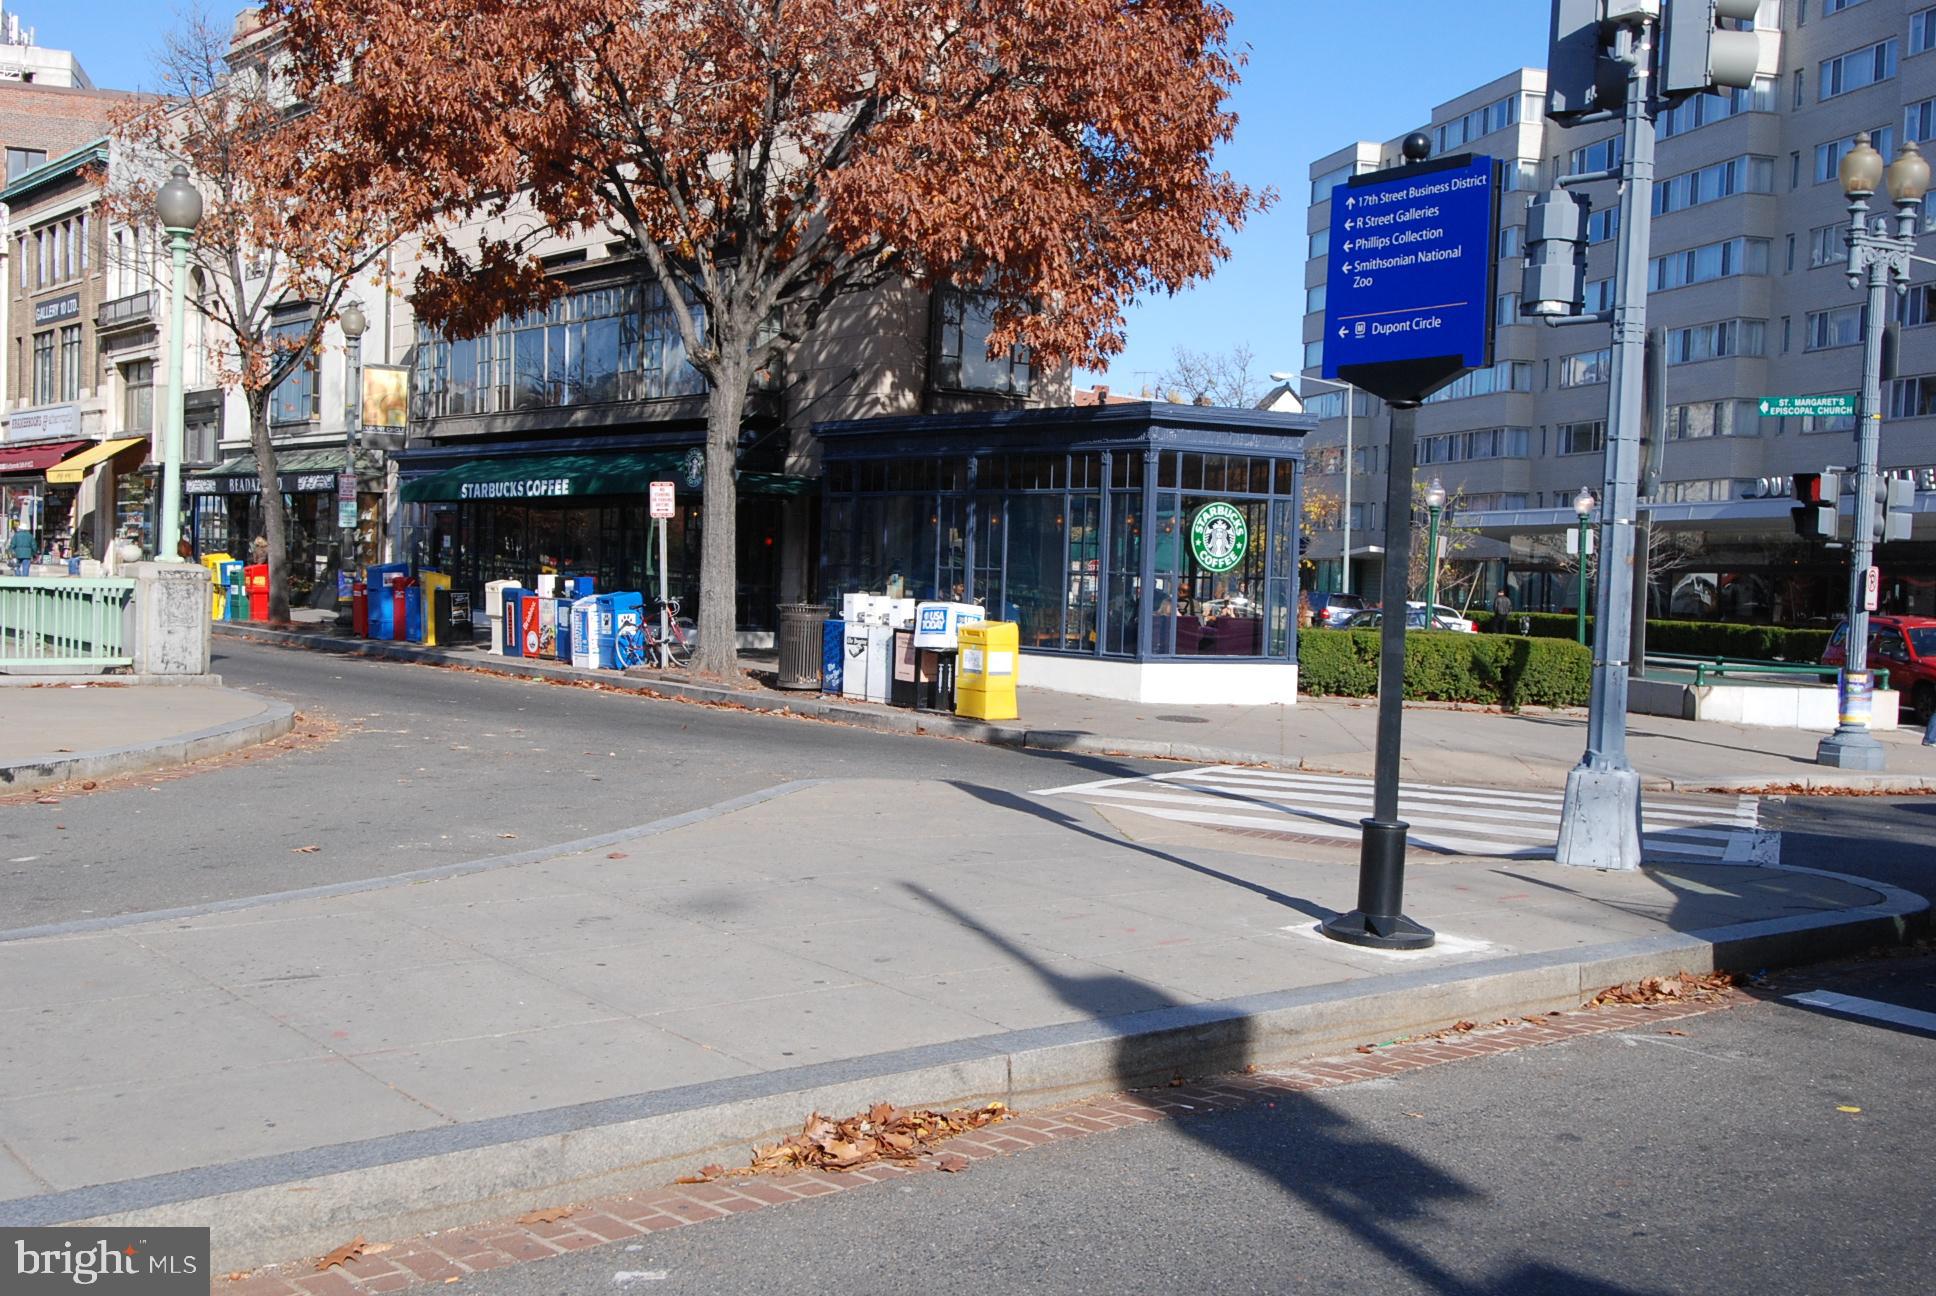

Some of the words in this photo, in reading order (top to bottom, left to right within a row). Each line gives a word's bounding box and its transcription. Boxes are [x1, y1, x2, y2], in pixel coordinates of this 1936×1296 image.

[1358, 194, 1379, 207] 17th
[1380, 189, 1407, 203] Street
[1408, 183, 1450, 198] Business
[1451, 175, 1487, 190] District
[1356, 217, 1364, 229] R
[1365, 212, 1395, 227] Street
[1396, 205, 1440, 222] Galleries
[1355, 236, 1390, 251] Phillips
[1392, 228, 1443, 245] Collection
[1354, 254, 1416, 272] Smithsonian
[1417, 244, 1462, 263] National
[1353, 276, 1373, 288] Zoo
[36, 303, 60, 320] GALLERY
[1372, 320, 1411, 336] Dupont
[1412, 316, 1442, 330] Circle
[1770, 407, 1815, 415] EPISCOPAL
[1817, 406, 1853, 414] CHURCH
[1779, 399, 1791, 407] ST.
[1795, 398, 1845, 406] MARGARET'S
[461, 481, 524, 499] STARBUCKS
[526, 479, 569, 497] COFFEE
[1195, 505, 1244, 537] STARBUCKS
[1199, 550, 1238, 568] COFFEE
[930, 610, 945, 620] USA
[922, 620, 945, 630] TODAY
